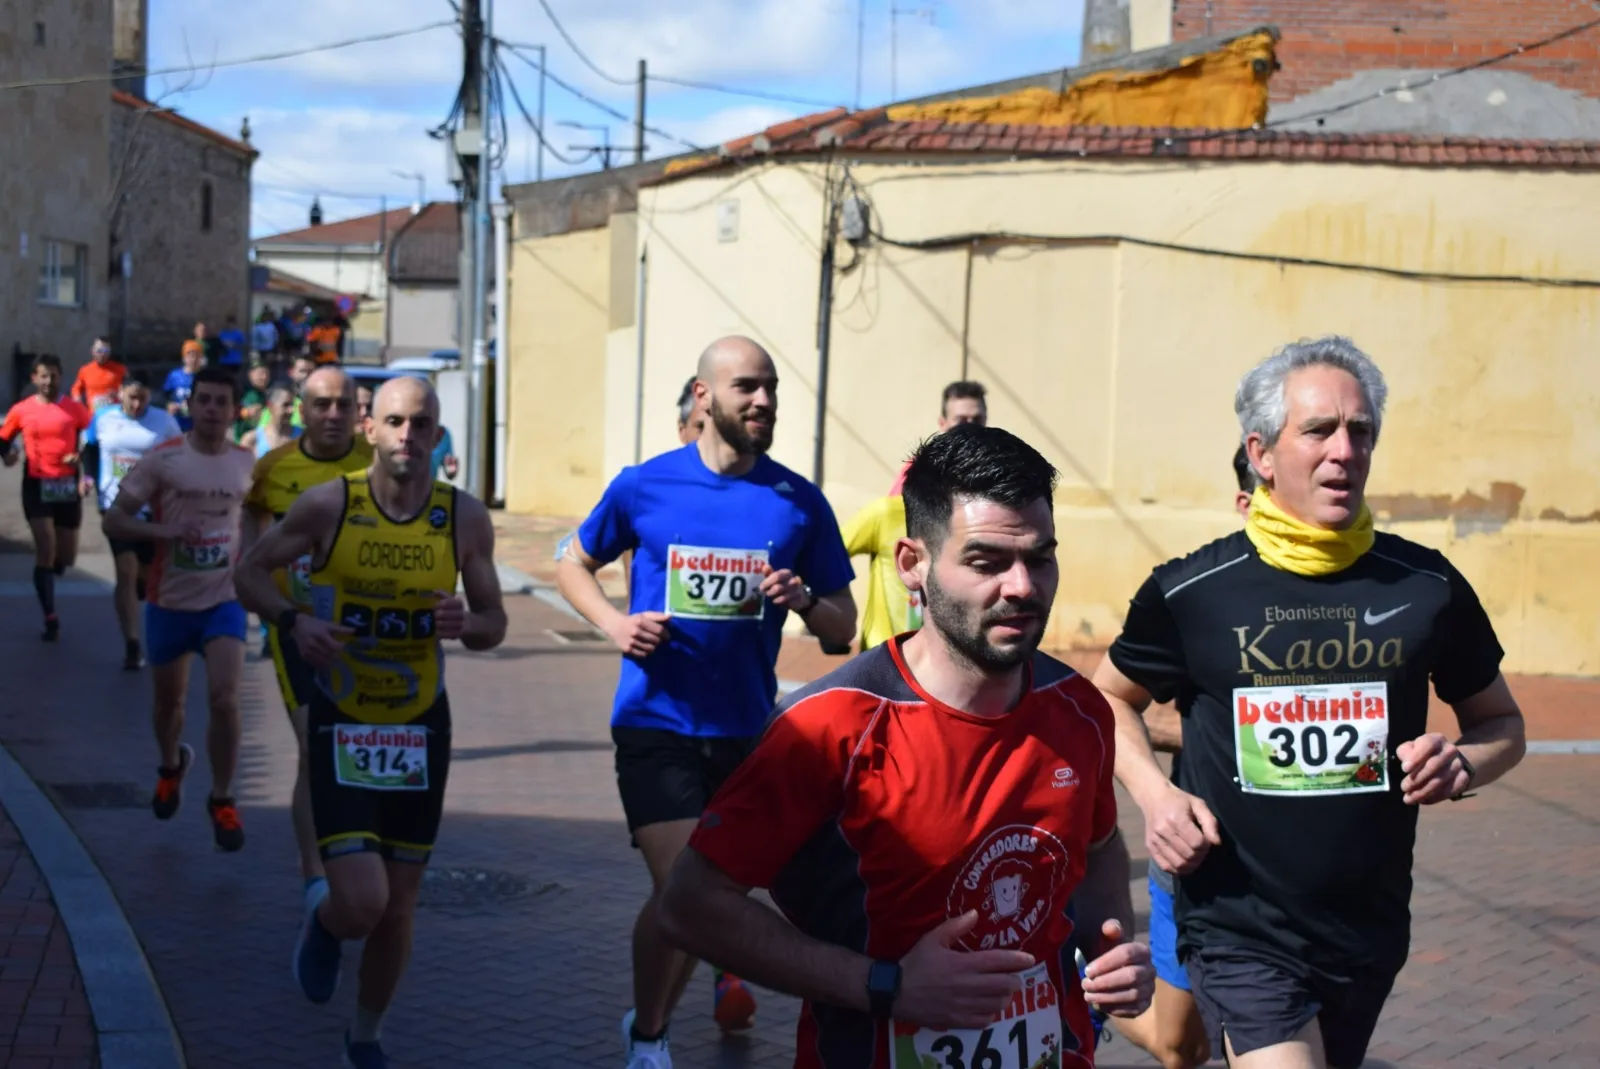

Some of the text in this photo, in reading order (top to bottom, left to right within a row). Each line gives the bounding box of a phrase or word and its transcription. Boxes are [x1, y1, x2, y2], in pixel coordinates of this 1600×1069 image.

[358, 541, 435, 571] CORDERO
[670, 550, 766, 575] bedunia
[687, 573, 747, 602] 370
[1264, 603, 1357, 622] Ebanisteria
[1231, 620, 1405, 674] Kaoba
[1253, 671, 1315, 687] Running
[1237, 689, 1385, 727] bedunia
[337, 728, 426, 747] bedunia
[1268, 724, 1360, 768] 302
[354, 748, 409, 773] 314
[963, 833, 1039, 890] CORREDORES
[930, 1019, 1029, 1069] 361
